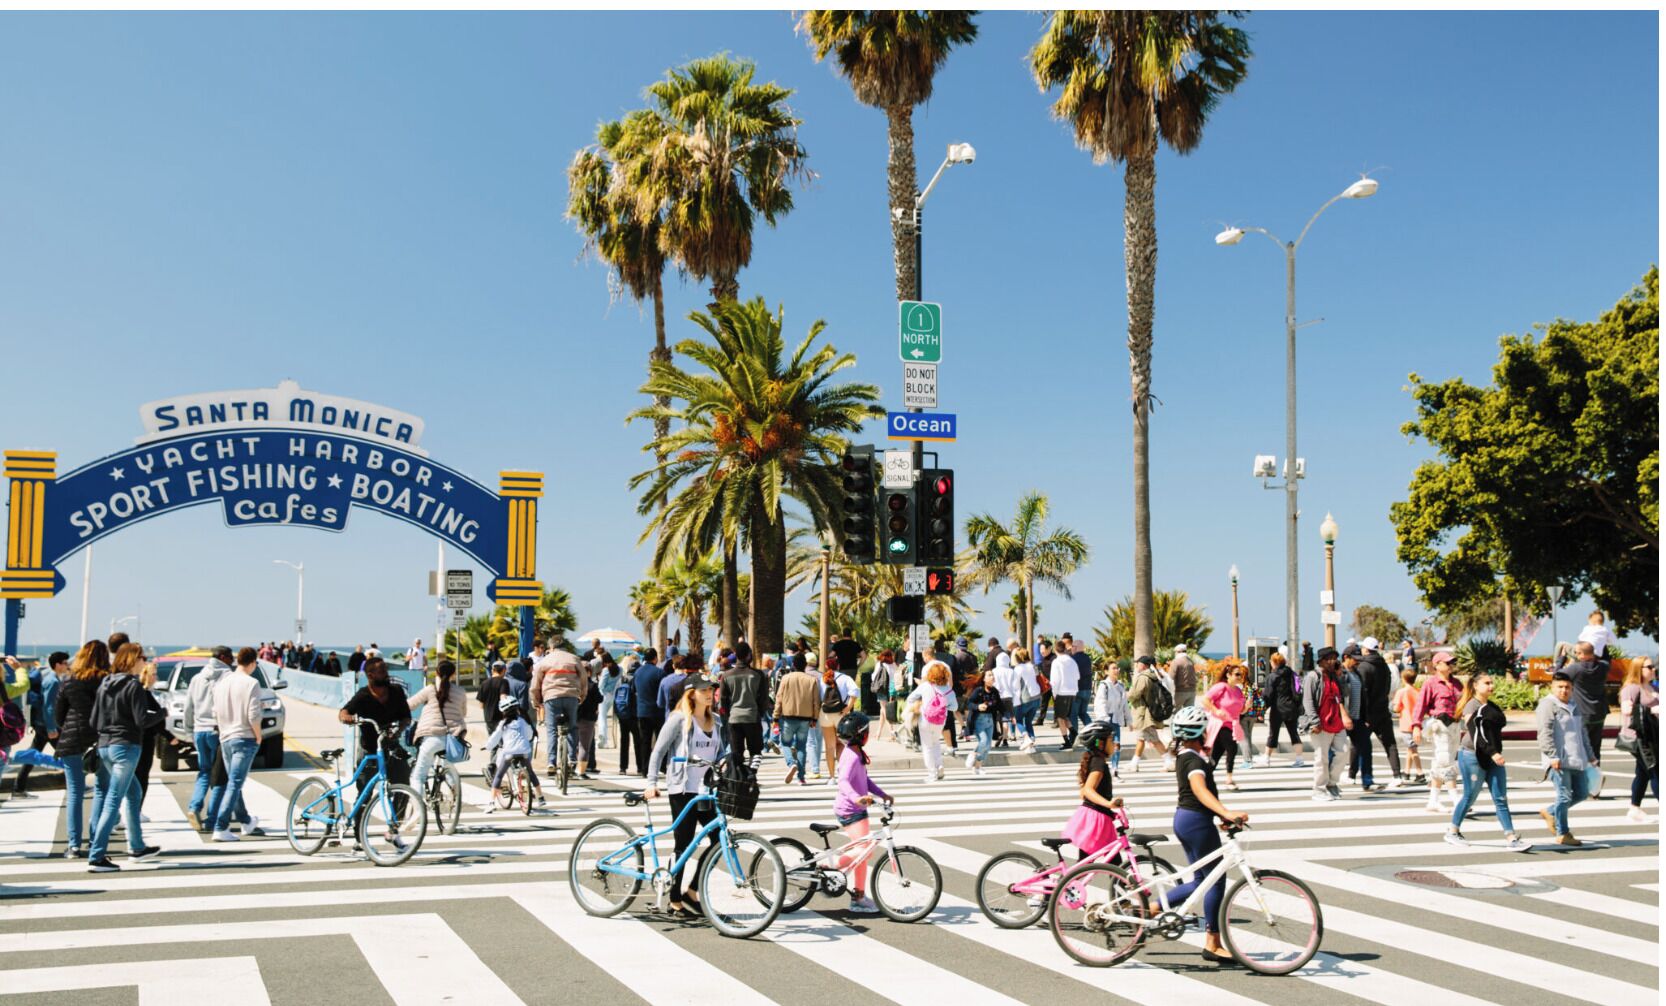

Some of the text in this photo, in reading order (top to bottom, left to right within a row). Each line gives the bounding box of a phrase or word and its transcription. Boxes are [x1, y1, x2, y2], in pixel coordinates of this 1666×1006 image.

[918, 312, 924, 327] 1
[903, 333, 939, 346] NORTH
[906, 368, 935, 380] DO NOT
[906, 382, 935, 395] BLOCK
[905, 396, 936, 405] INTERSECTION
[154, 398, 414, 443] SANTA MONICA
[893, 415, 952, 433] Ocean
[135, 437, 432, 487] YACHT HARBOR
[886, 474, 911, 483] SIGNAL
[69, 463, 480, 544] SPORT FISHING BOATING
[904, 582, 913, 593] OK
[945, 575, 952, 591] 3
